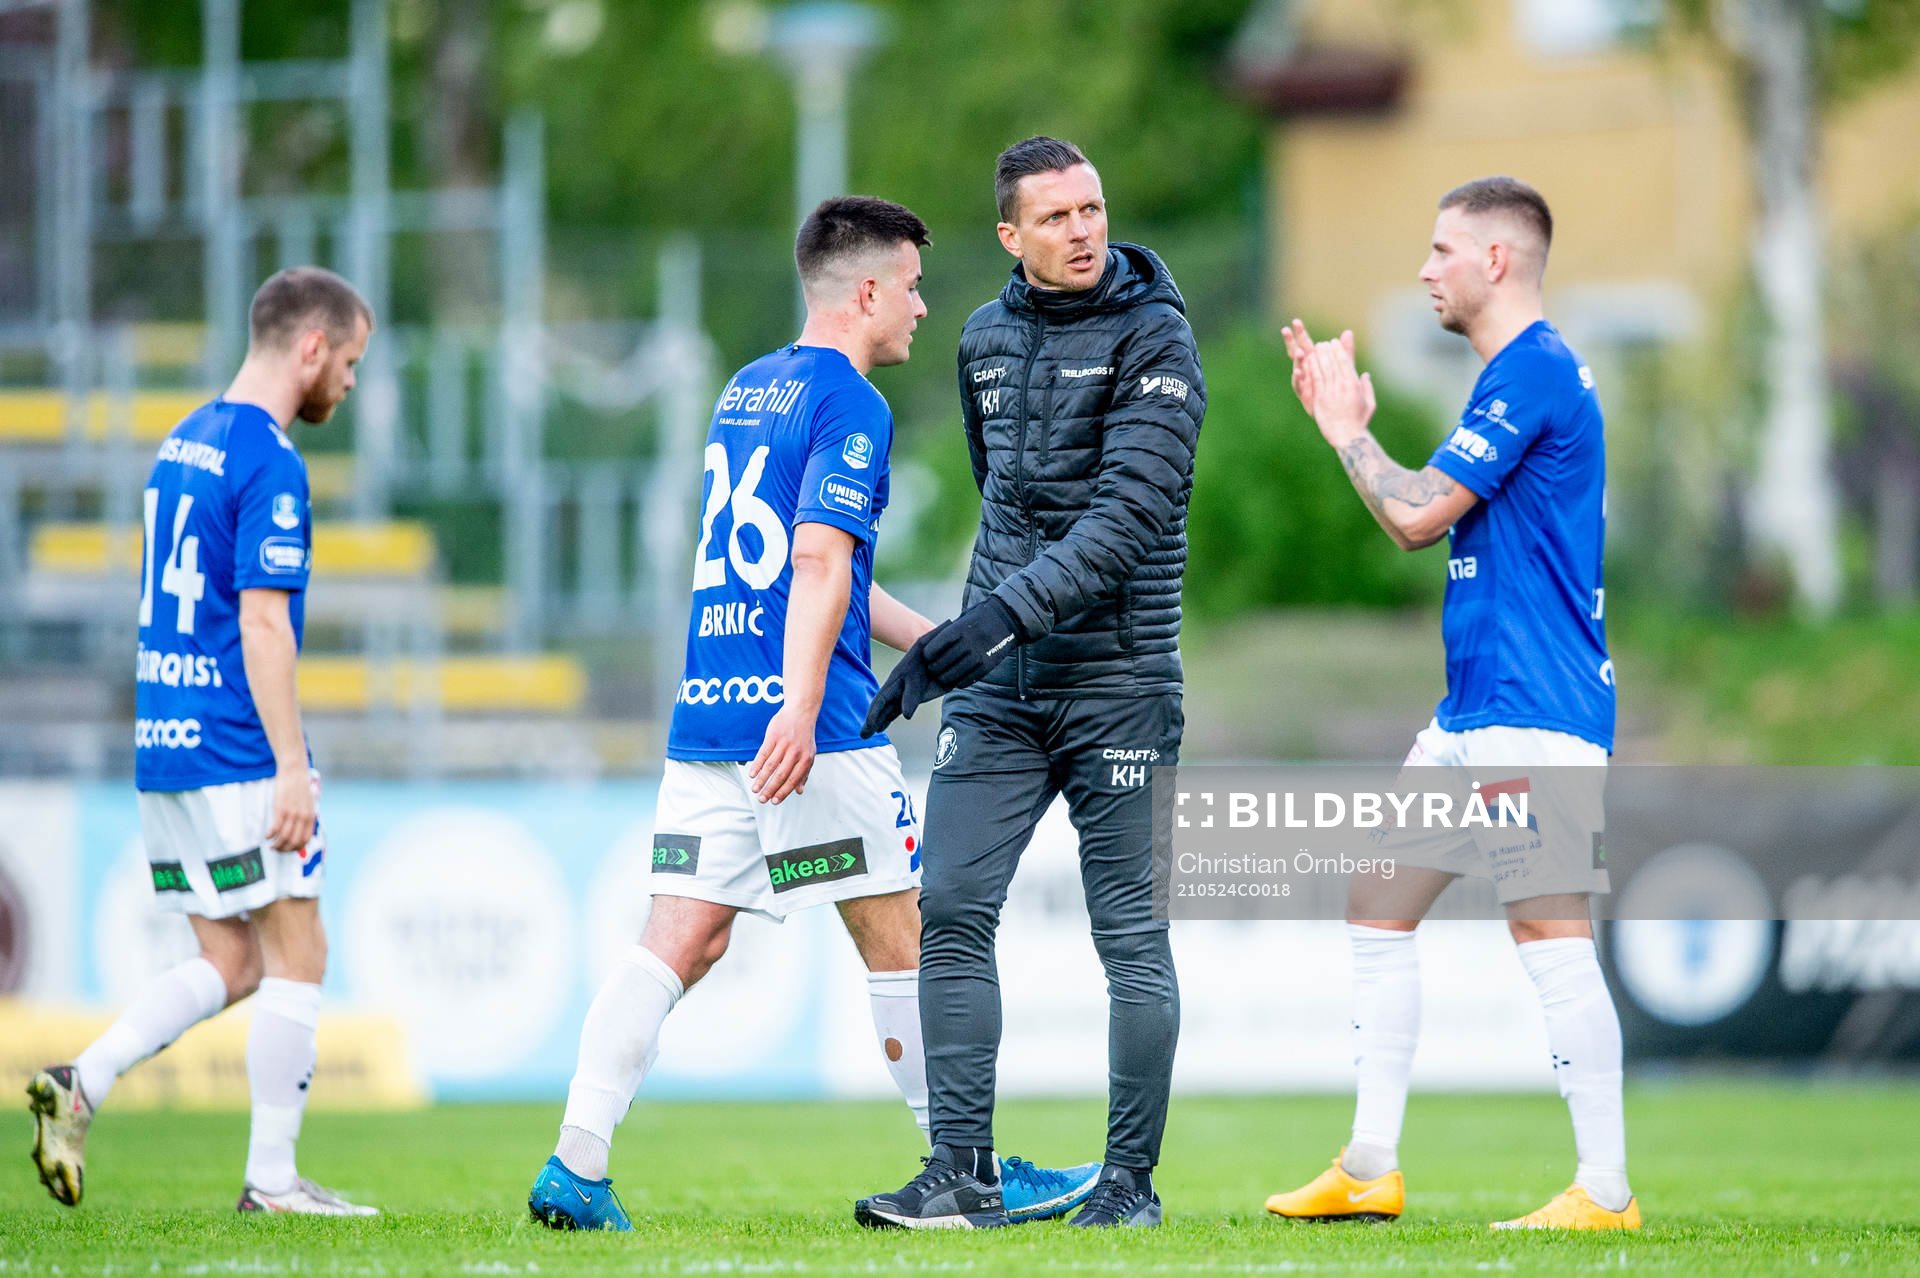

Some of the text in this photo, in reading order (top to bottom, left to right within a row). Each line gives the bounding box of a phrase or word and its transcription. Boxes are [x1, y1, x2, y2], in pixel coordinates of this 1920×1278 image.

[973, 368, 1003, 383] CRAFT
[1162, 376, 1188, 391] INTER
[982, 389, 1001, 415] KH
[1160, 384, 1188, 401] SPORT
[827, 482, 870, 508] UNIBET
[692, 442, 789, 592] 26
[139, 487, 206, 635] 14
[698, 600, 765, 637] BRKIĆ
[1102, 748, 1151, 761] CRAFT
[1111, 764, 1145, 787] KH
[769, 856, 830, 886] akea
